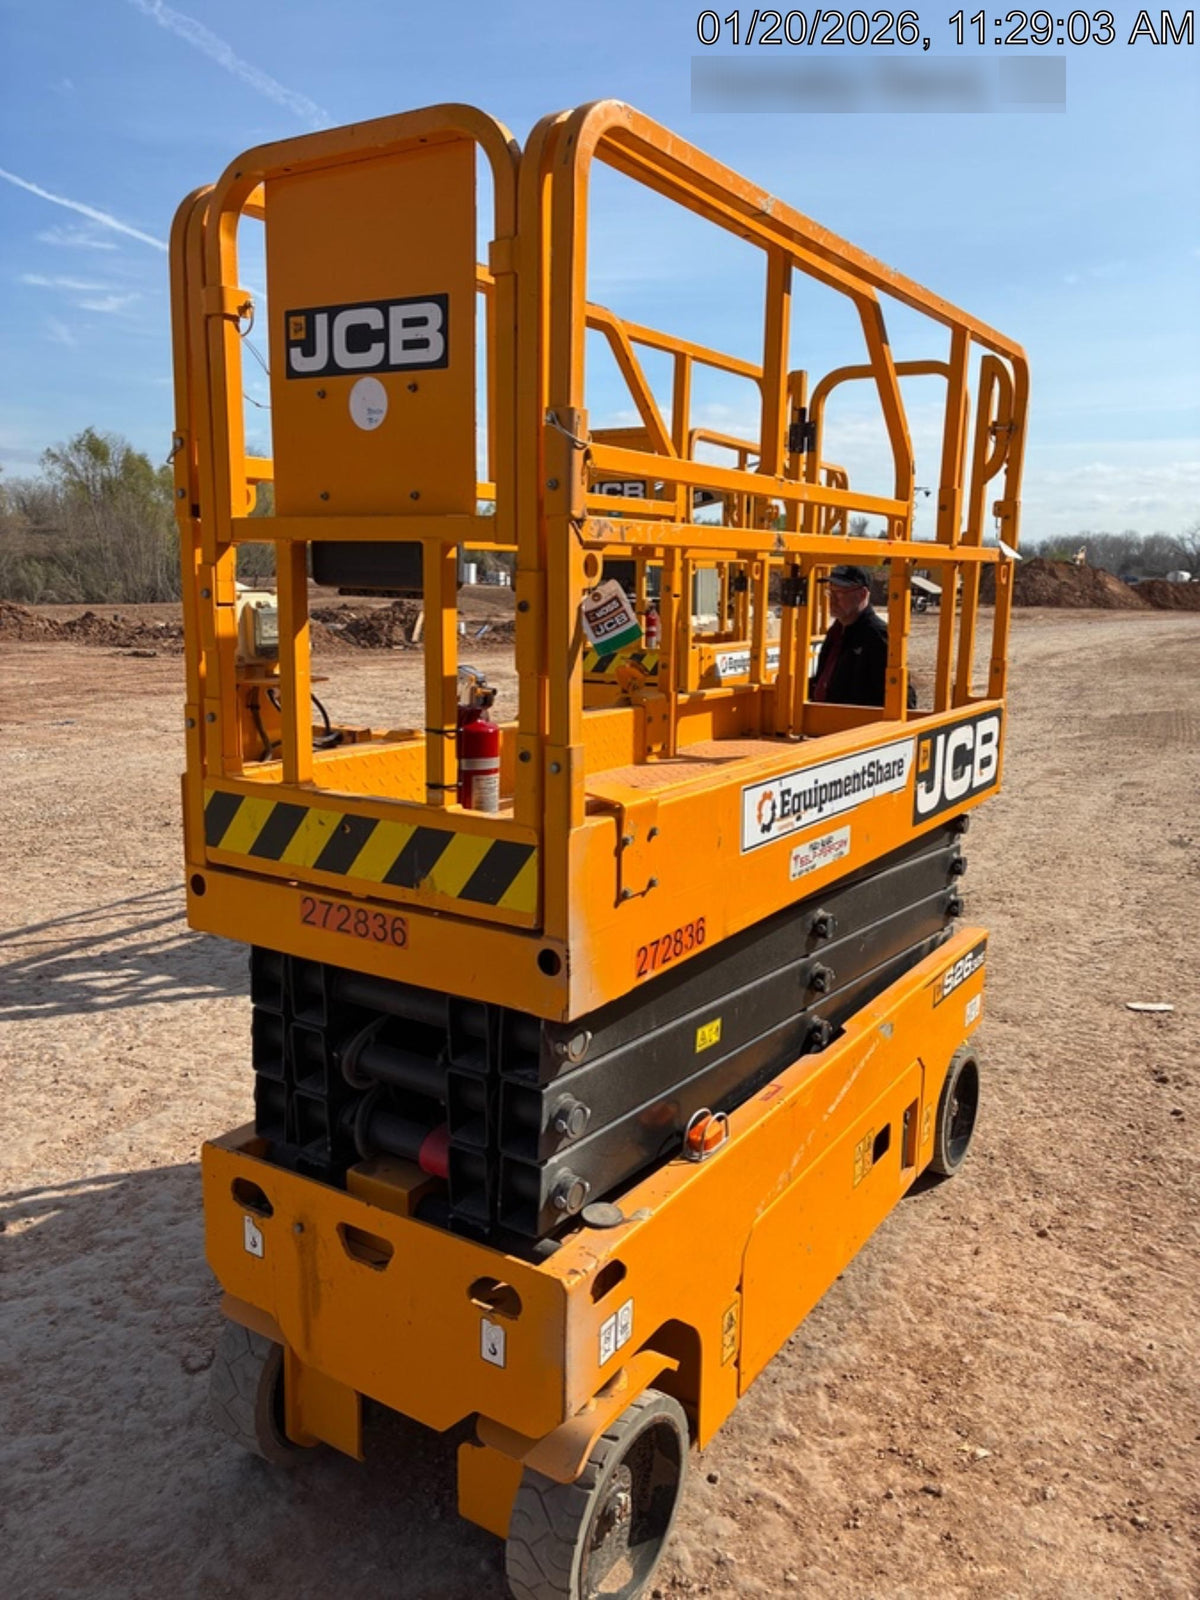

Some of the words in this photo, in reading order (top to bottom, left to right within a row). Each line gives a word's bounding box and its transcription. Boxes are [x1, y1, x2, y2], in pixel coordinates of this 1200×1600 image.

[289, 301, 445, 373] JCB
[594, 612, 629, 636] JCB
[780, 757, 905, 821] EquipmentShare
[917, 716, 999, 814] JCB
[301, 896, 407, 947] 272836
[636, 916, 705, 978] 272836
